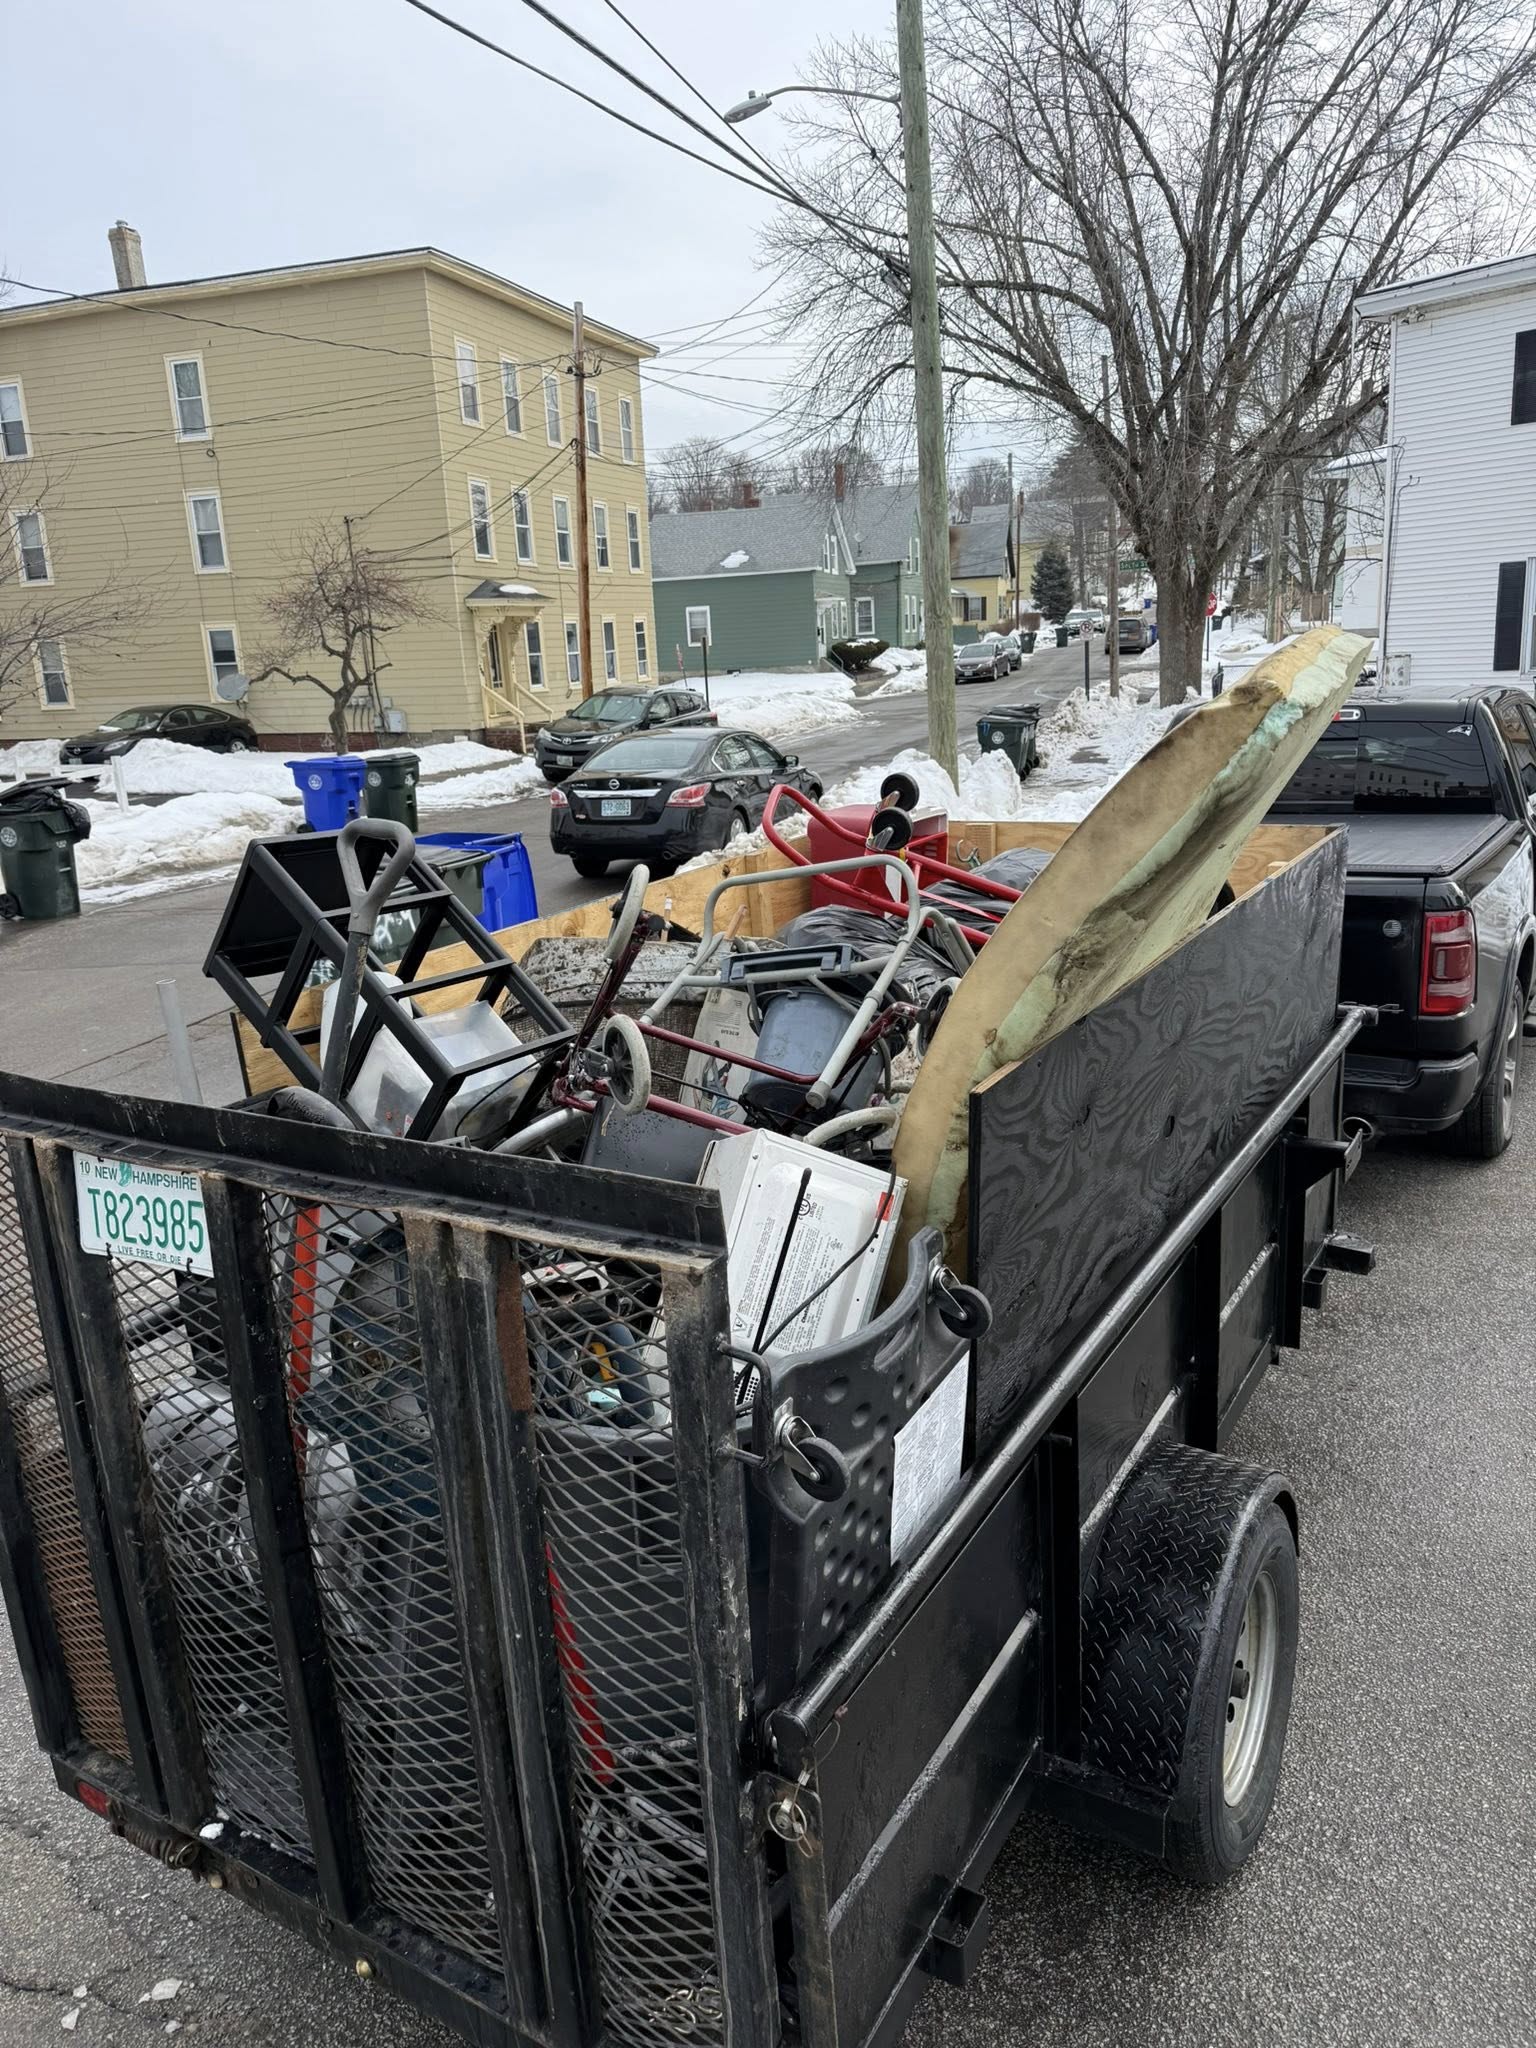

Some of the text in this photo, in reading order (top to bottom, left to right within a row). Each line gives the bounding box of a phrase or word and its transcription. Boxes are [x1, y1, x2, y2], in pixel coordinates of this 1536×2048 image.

[79, 1161, 91, 1175] 10
[94, 1165, 197, 1191] NEW HAMPSHIRE
[87, 1187, 204, 1254] T823985
[117, 1245, 182, 1265] LIVE FREE OR DIE
